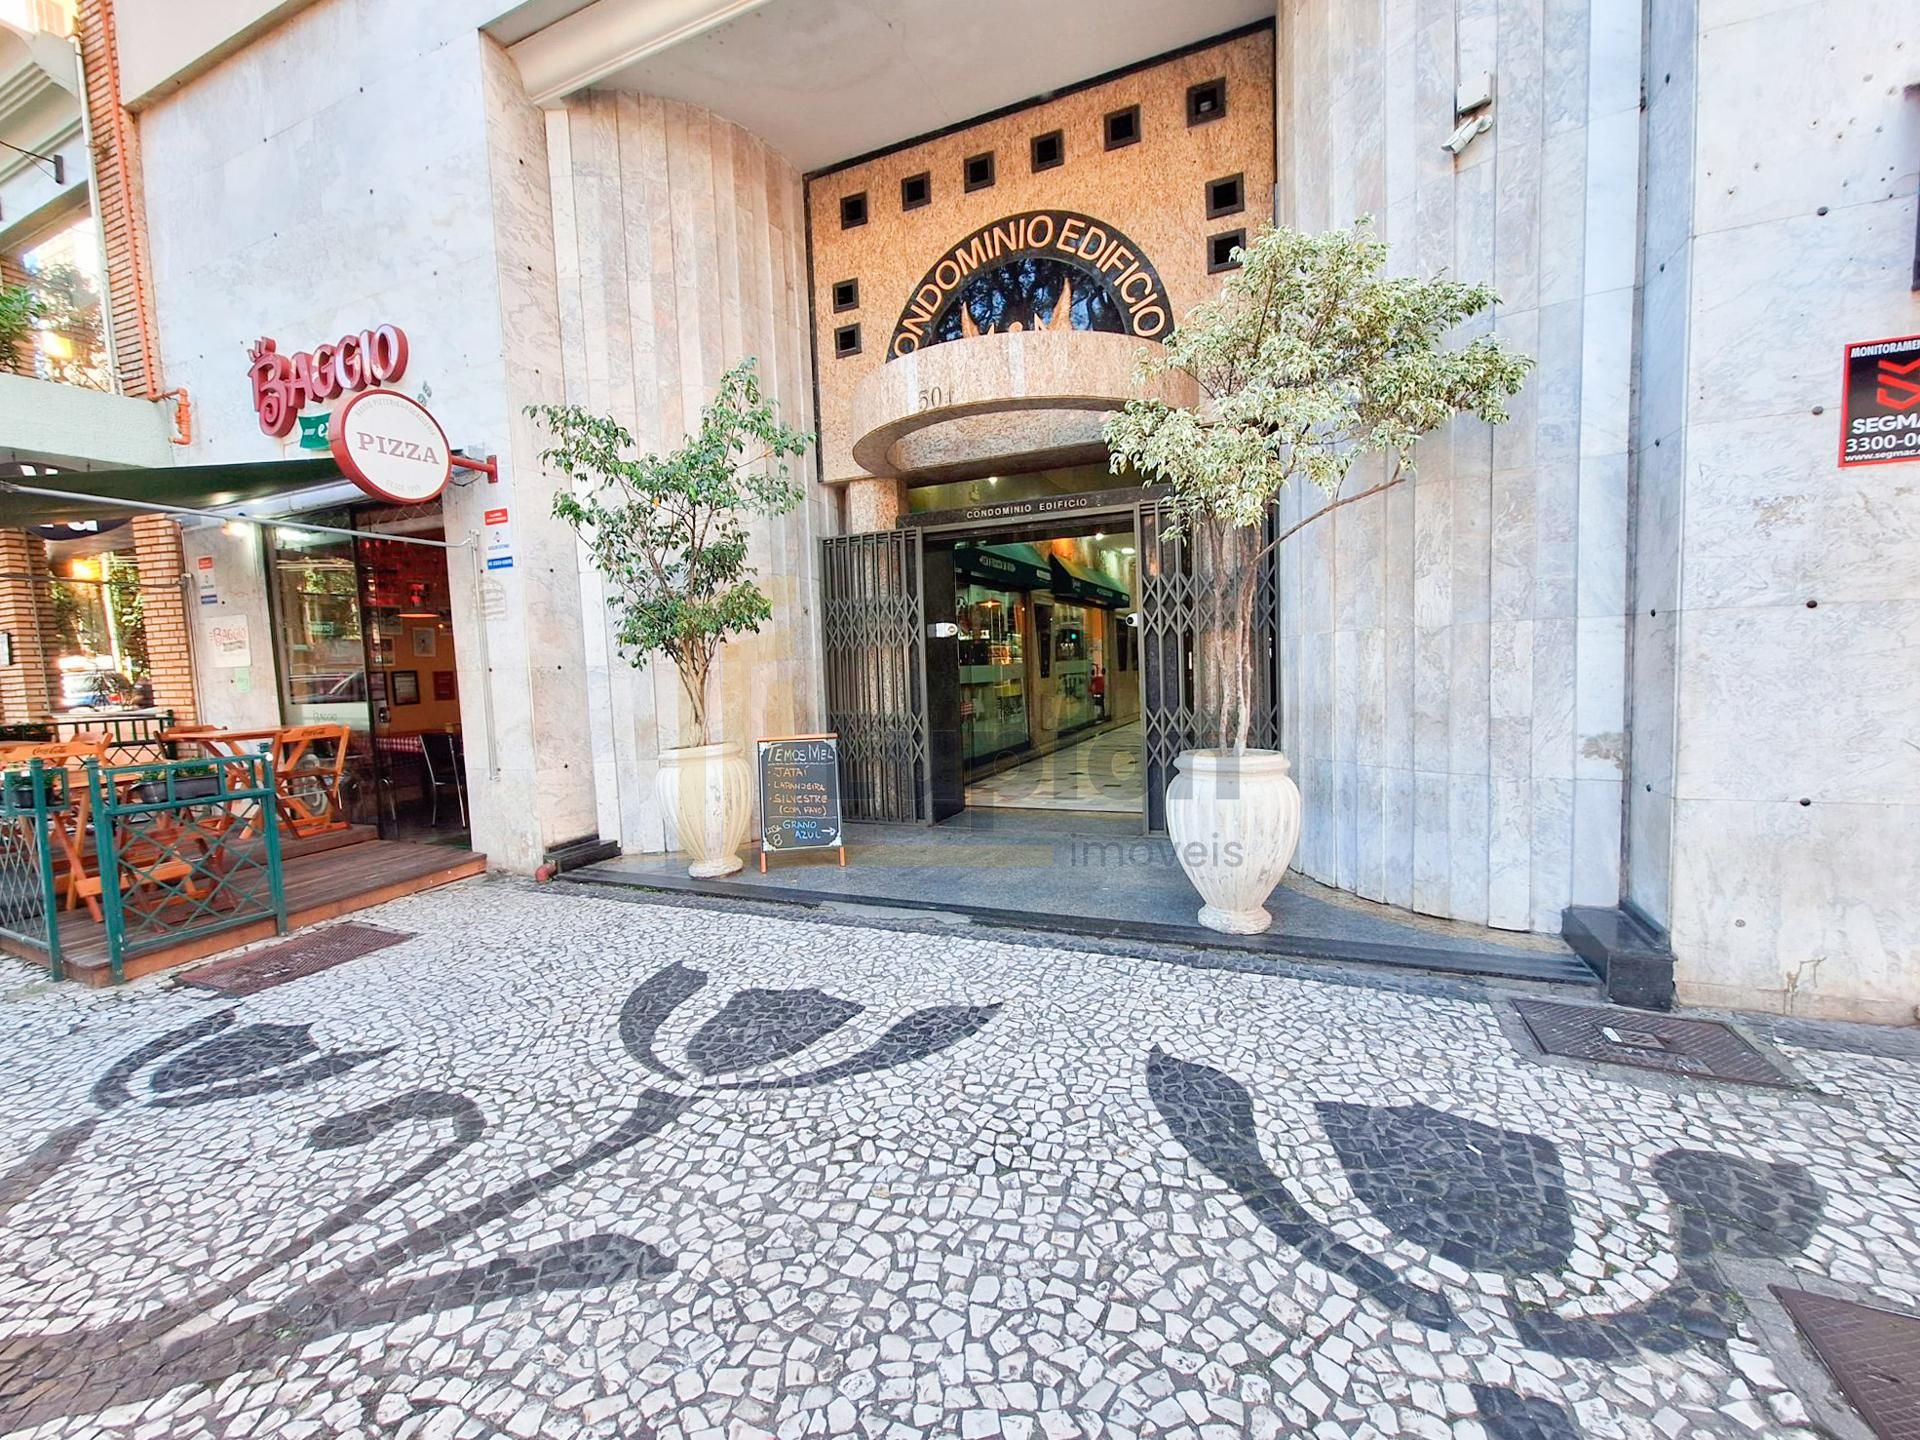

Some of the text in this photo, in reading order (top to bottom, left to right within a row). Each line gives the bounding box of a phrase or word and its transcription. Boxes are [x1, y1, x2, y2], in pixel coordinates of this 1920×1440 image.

[894, 215, 1054, 357] ONDOMINIO
[1056, 217, 1165, 337] EDIFICIO
[247, 324, 409, 437] BAGGIO
[1852, 413, 1920, 435] SEGM
[356, 431, 440, 465] PIZZA
[1845, 432, 1920, 453] 3300-0
[966, 498, 1088, 519] CONDOMINIO EDIFICIO
[767, 743, 834, 761] TEMOS MEL
[794, 830, 822, 840] AZUL
